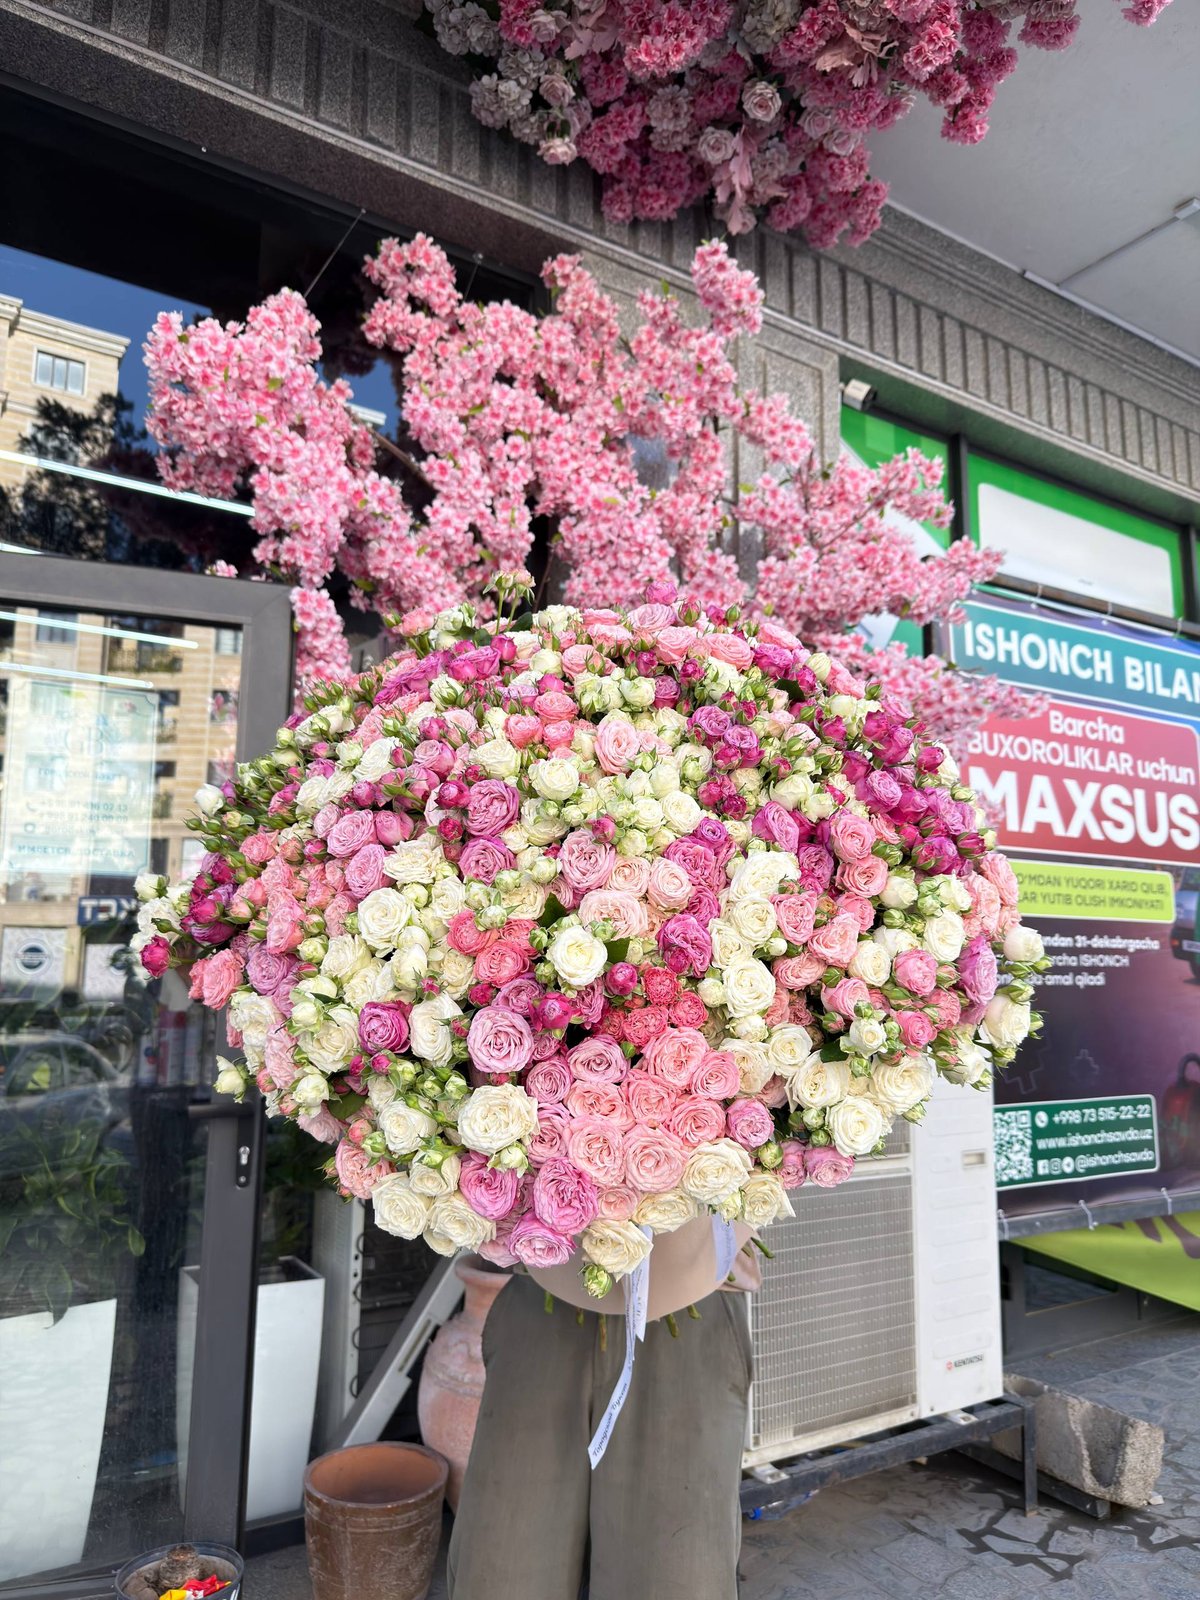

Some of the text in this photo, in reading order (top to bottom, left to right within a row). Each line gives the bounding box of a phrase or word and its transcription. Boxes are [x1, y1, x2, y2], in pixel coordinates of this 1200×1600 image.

[964, 621, 1114, 684] ISHONCH
[1049, 709, 1125, 745] Barcha
[967, 731, 1196, 786] BUXOROLIKLAR uchun
[968, 766, 1200, 851] MAXSUS
[1080, 954, 1130, 967] ISHONCH
